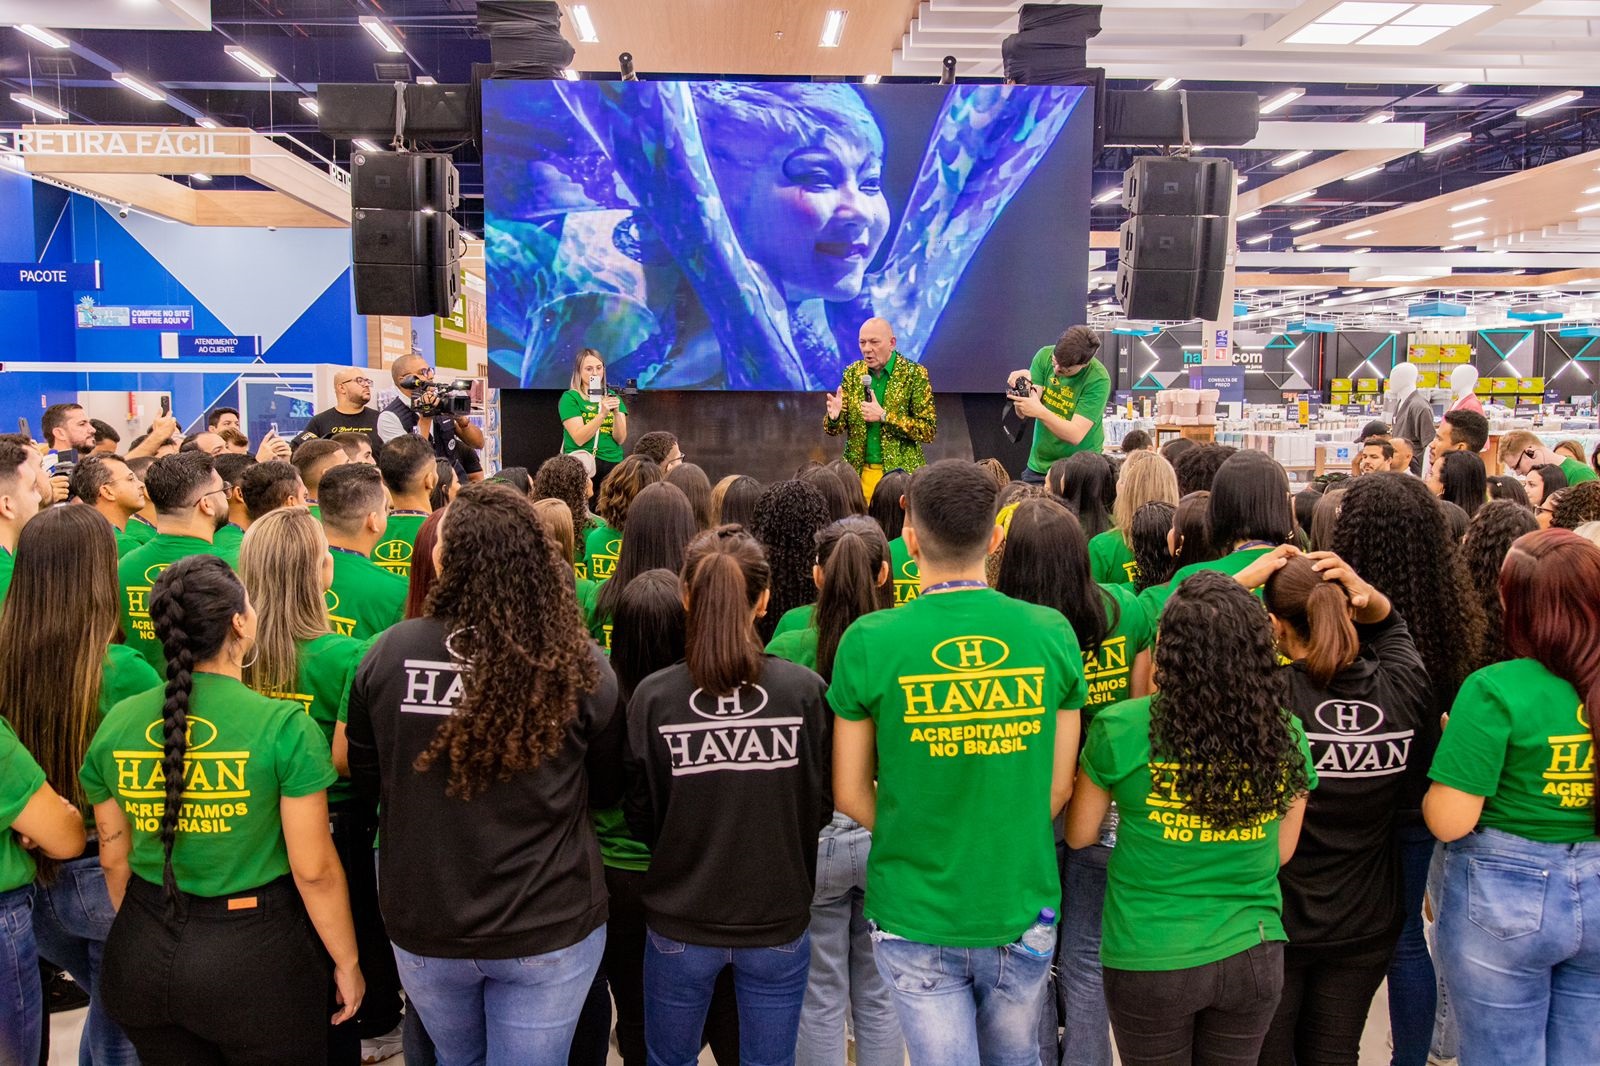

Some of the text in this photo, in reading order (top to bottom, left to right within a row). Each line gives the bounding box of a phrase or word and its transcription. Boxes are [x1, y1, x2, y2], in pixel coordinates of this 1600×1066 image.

[13, 127, 225, 155] RETIRA FÁCIL
[19, 270, 67, 282] PACOTE
[131, 309, 162, 317] COMPRE
[163, 309, 174, 317] NO
[132, 317, 181, 325] E RETIRE AQUI
[194, 338, 239, 346] ATENDIMENTO
[208, 346, 235, 354] CLIENTE
[388, 542, 403, 559] H
[956, 639, 987, 668] H
[901, 675, 1045, 715] HAVAN
[1334, 703, 1361, 731] H
[910, 720, 1041, 743] ACREDITAMOS
[663, 725, 800, 767] HAVAN
[929, 737, 1027, 757] NO BRASIL
[1307, 738, 1413, 771] AVAN
[1560, 796, 1589, 808] NO
[135, 817, 232, 834] NO RASIL
[1163, 826, 1266, 842] NO BRASIL
